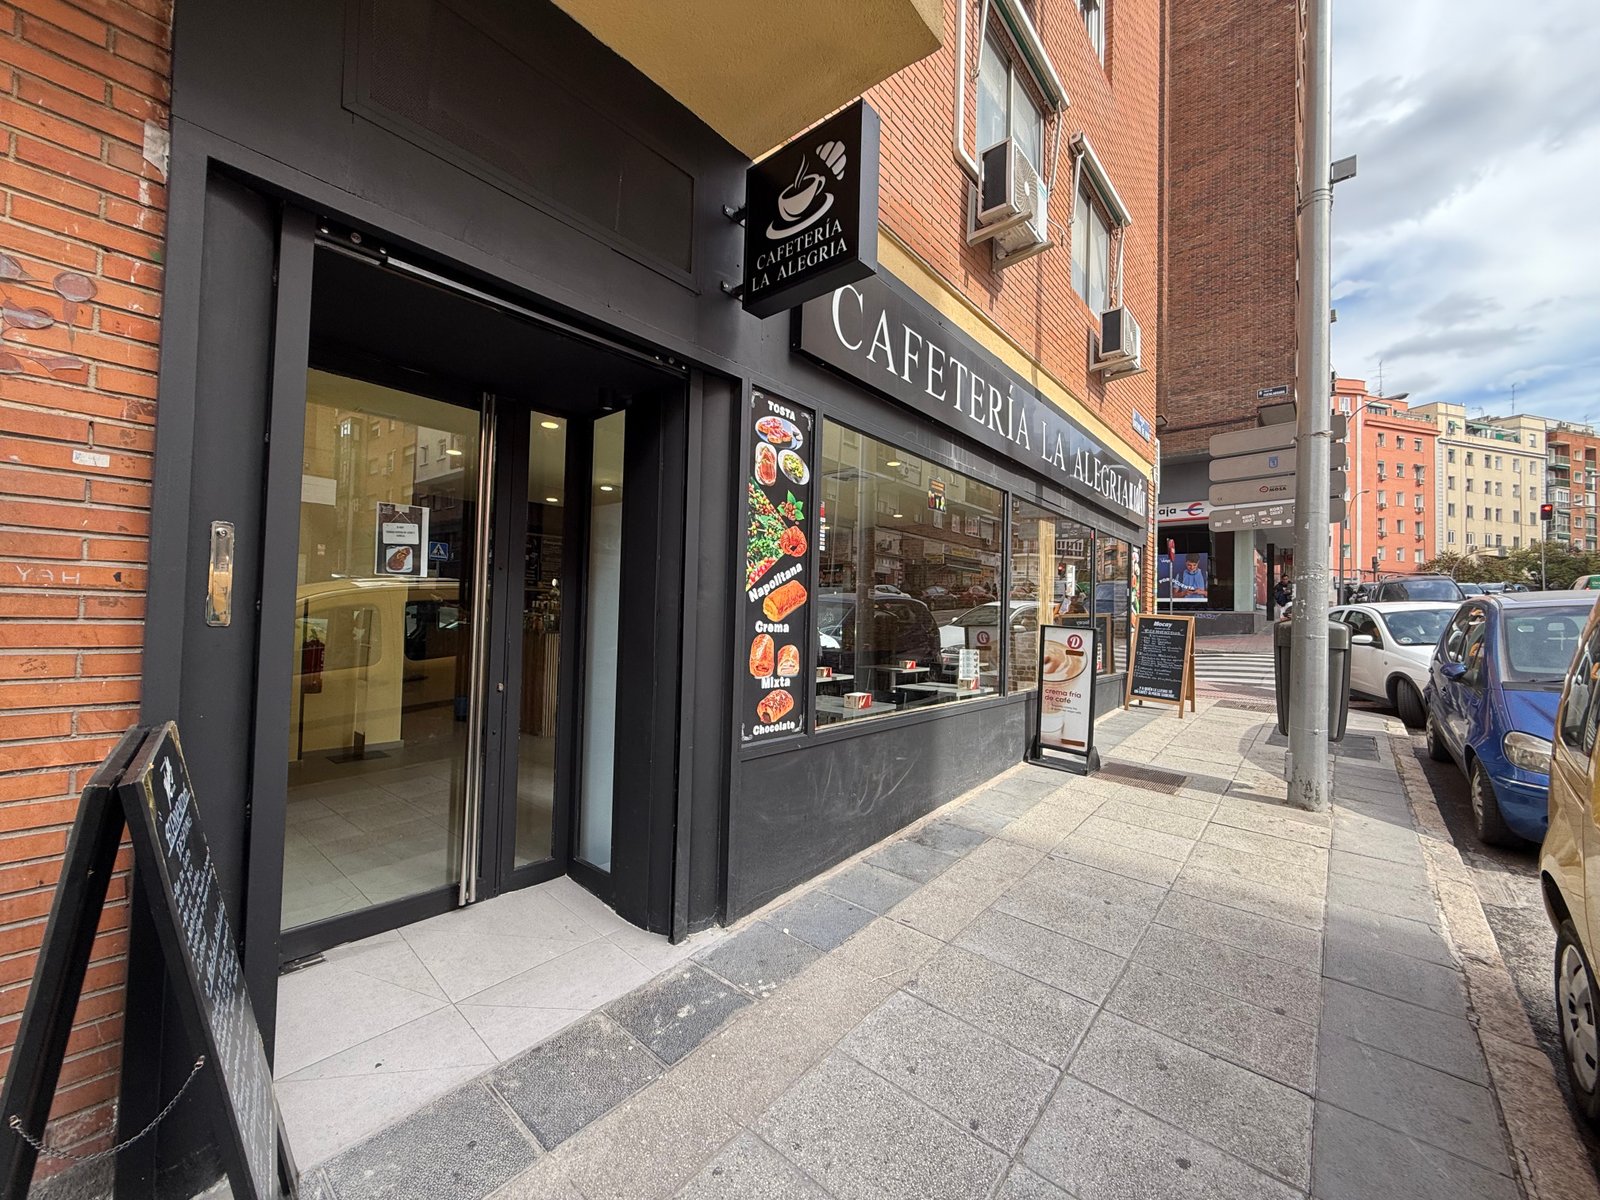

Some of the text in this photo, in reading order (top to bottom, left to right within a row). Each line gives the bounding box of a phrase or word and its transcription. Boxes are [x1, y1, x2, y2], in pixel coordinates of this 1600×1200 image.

[756, 218, 842, 270] CAFETERÍA
[752, 275, 770, 292] LA
[832, 284, 1031, 451] CAFETERÍA
[1041, 421, 1067, 472] LA
[767, 400, 796, 422] TOSTA
[1158, 506, 1177, 517] aja
[749, 562, 803, 603] Napolitana
[755, 620, 790, 633] Crema
[761, 676, 791, 689] Mixta
[1044, 688, 1081, 699] crema fría
[753, 720, 796, 736] Chocolate
